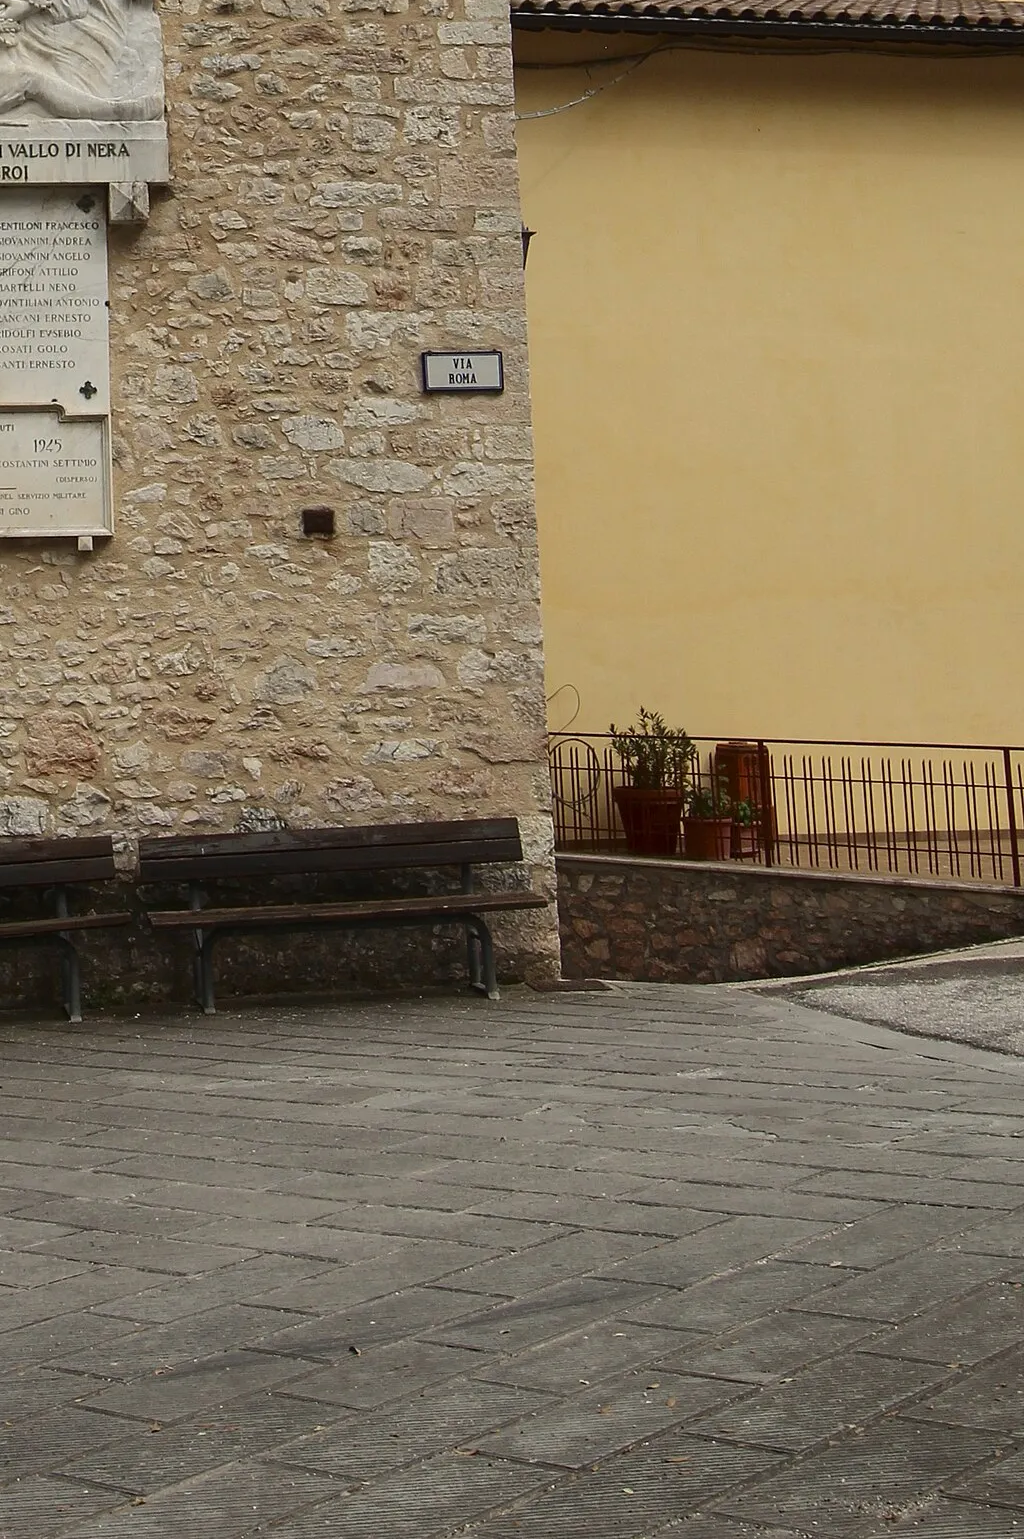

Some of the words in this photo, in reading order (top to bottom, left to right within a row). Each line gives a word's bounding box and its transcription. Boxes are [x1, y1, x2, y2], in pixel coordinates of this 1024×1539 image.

[8, 143, 59, 158] VALLO
[65, 143, 81, 157] DI
[87, 142, 130, 157] NERA
[46, 222, 100, 230] FRANCESCO
[52, 237, 92, 246] ANDREA
[52, 252, 91, 261] ANGELO
[39, 267, 78, 276] ATTILIO
[49, 283, 76, 292] NENO
[56, 298, 100, 307] ANTONIO
[46, 314, 91, 322] ERNESTO
[37, 345, 68, 353] GOLO
[30, 360, 75, 369] ERNESTO
[453, 358, 473, 369] VIA
[448, 373, 477, 384] ROMA
[34, 439, 62, 453] 1945
[53, 459, 97, 468] SETTIMIO
